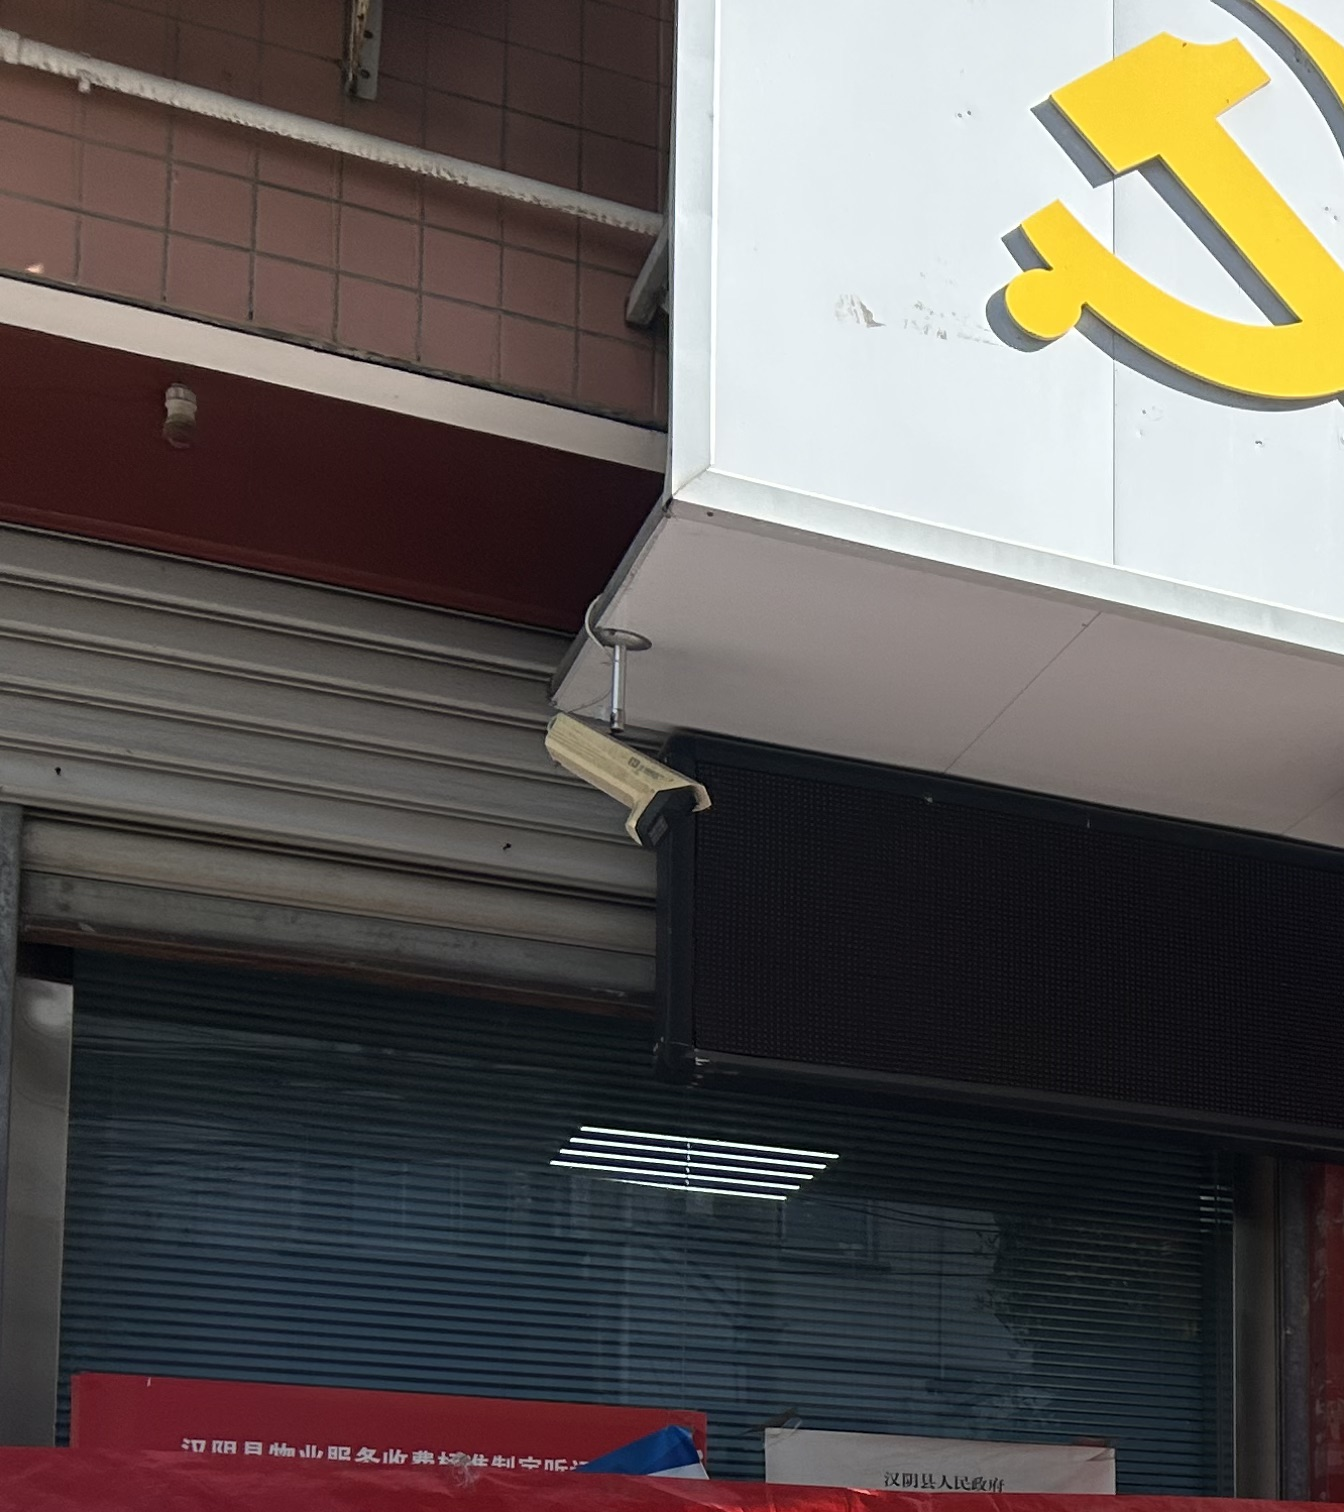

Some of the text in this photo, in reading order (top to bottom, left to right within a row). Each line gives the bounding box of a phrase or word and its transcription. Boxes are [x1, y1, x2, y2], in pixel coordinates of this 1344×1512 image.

[884, 1471, 1005, 1494] 汉阴县人民政府
